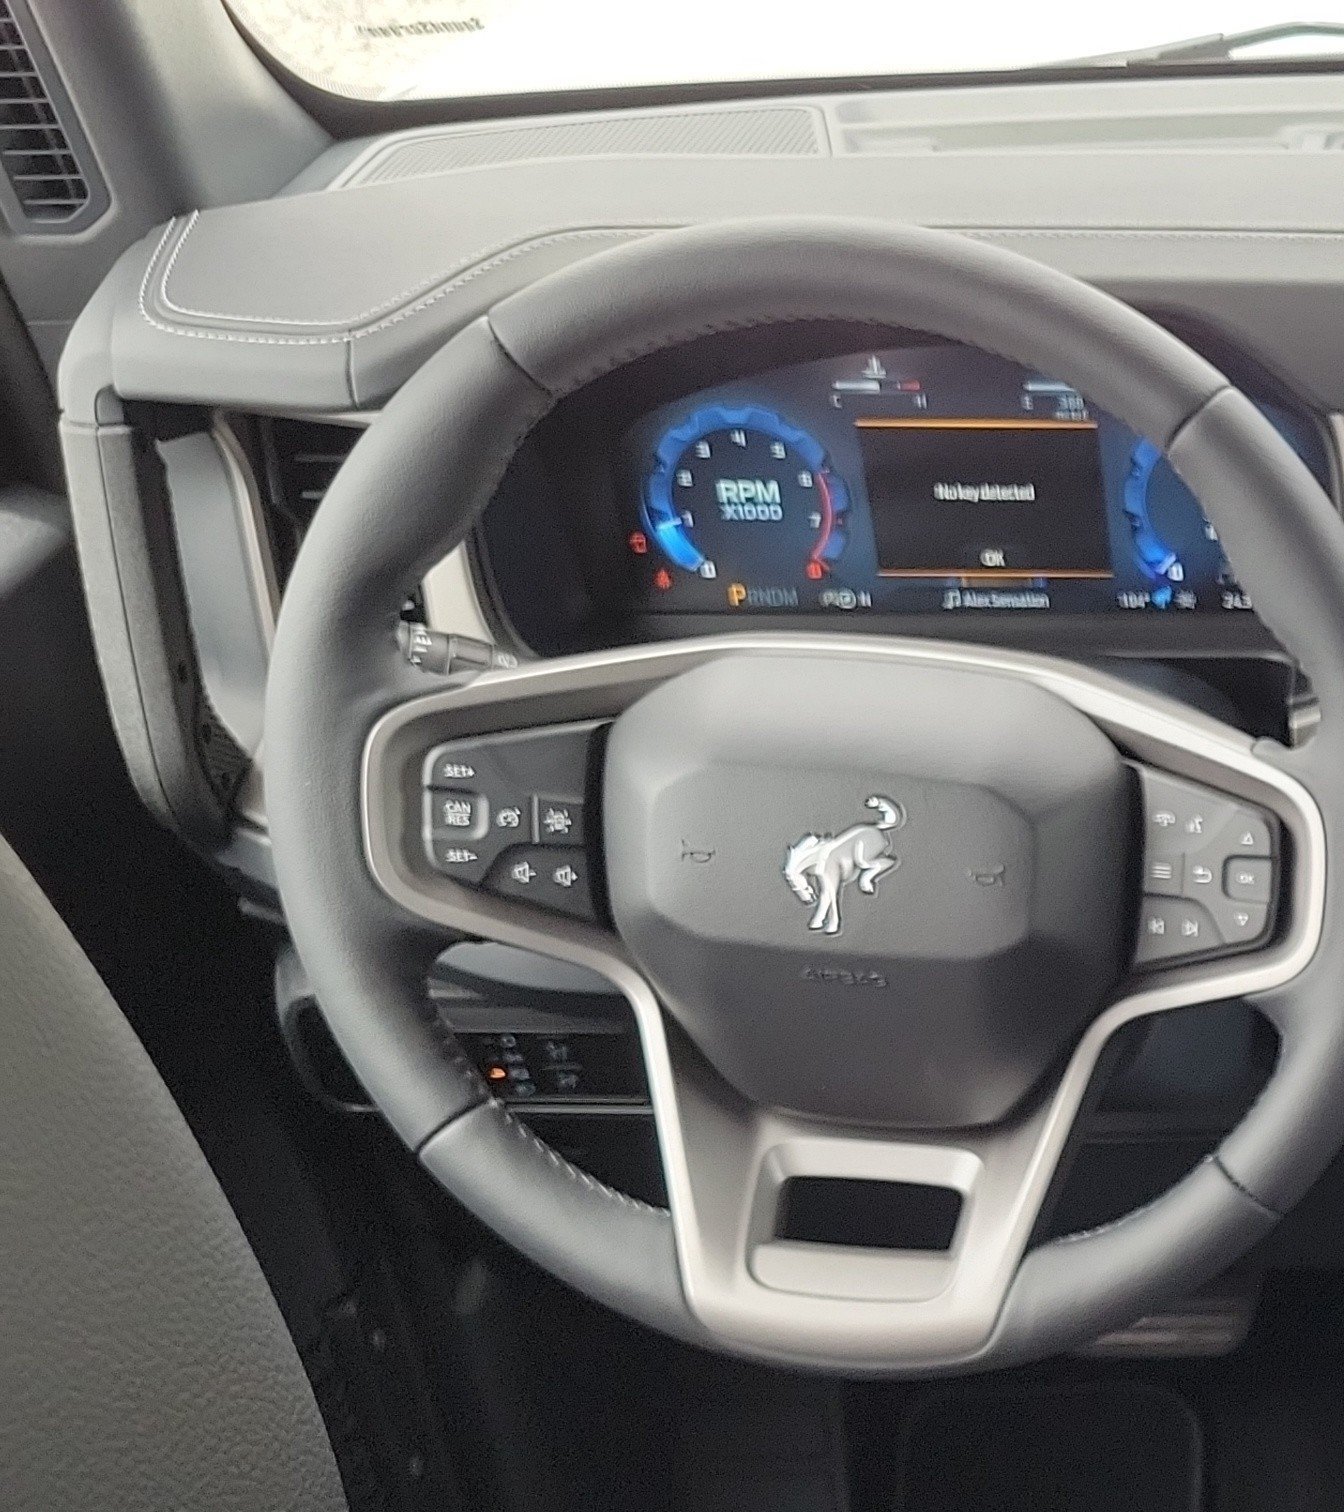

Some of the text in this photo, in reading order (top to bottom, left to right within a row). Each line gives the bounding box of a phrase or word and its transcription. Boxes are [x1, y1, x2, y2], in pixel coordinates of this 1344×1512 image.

[715, 479, 782, 504] RPM
[980, 482, 1035, 501] detected
[720, 503, 783, 521] X1000
[443, 800, 471, 814] CAN
